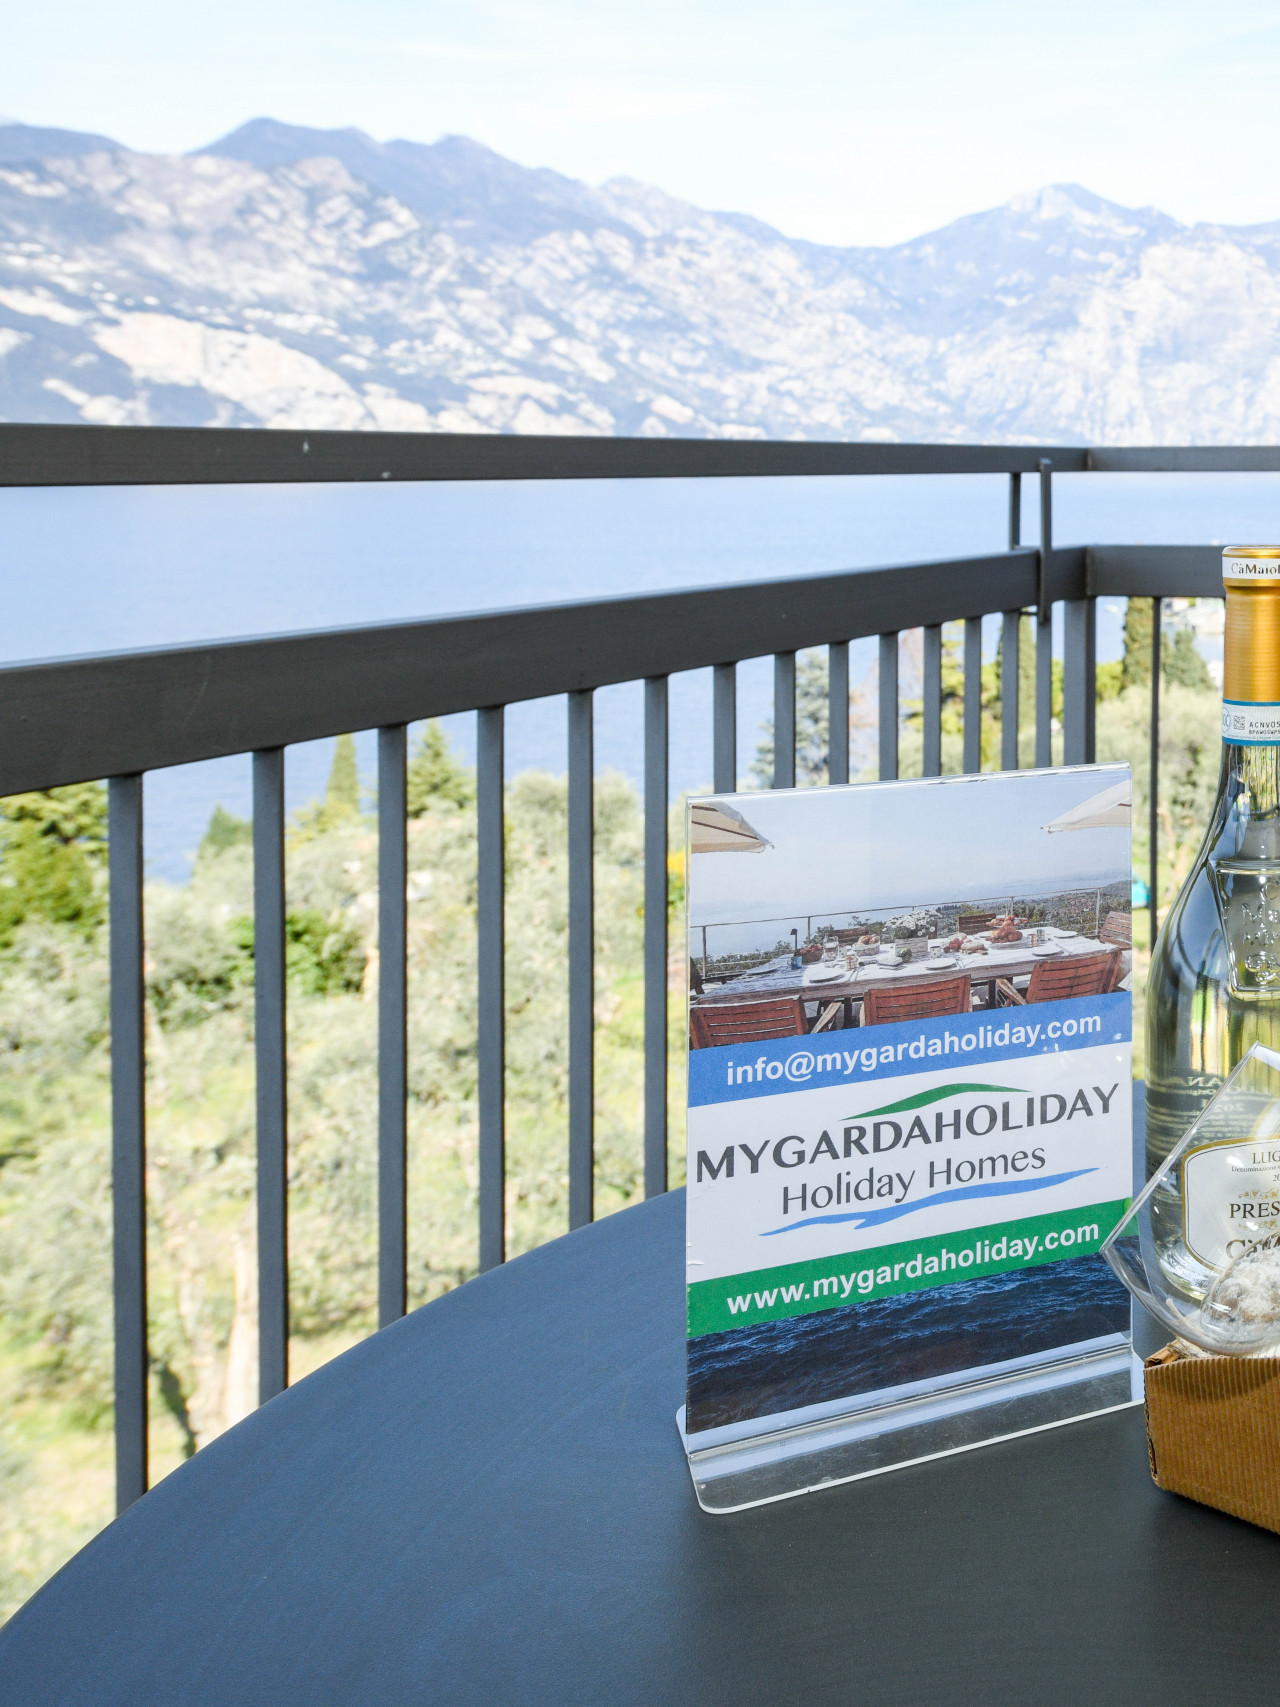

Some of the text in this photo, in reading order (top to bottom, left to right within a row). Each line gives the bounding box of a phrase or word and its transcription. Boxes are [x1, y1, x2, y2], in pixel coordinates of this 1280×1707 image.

[727, 1015, 1101, 1086] info@mygardaholiday.com
[696, 1083, 1119, 1183] MYGARDAHOLIDAY
[783, 1147, 1046, 1215] Holiday Homes
[1231, 1165, 1277, 1173] Denominazione
[727, 1222, 1100, 1315] www.mygardaholiday.com
